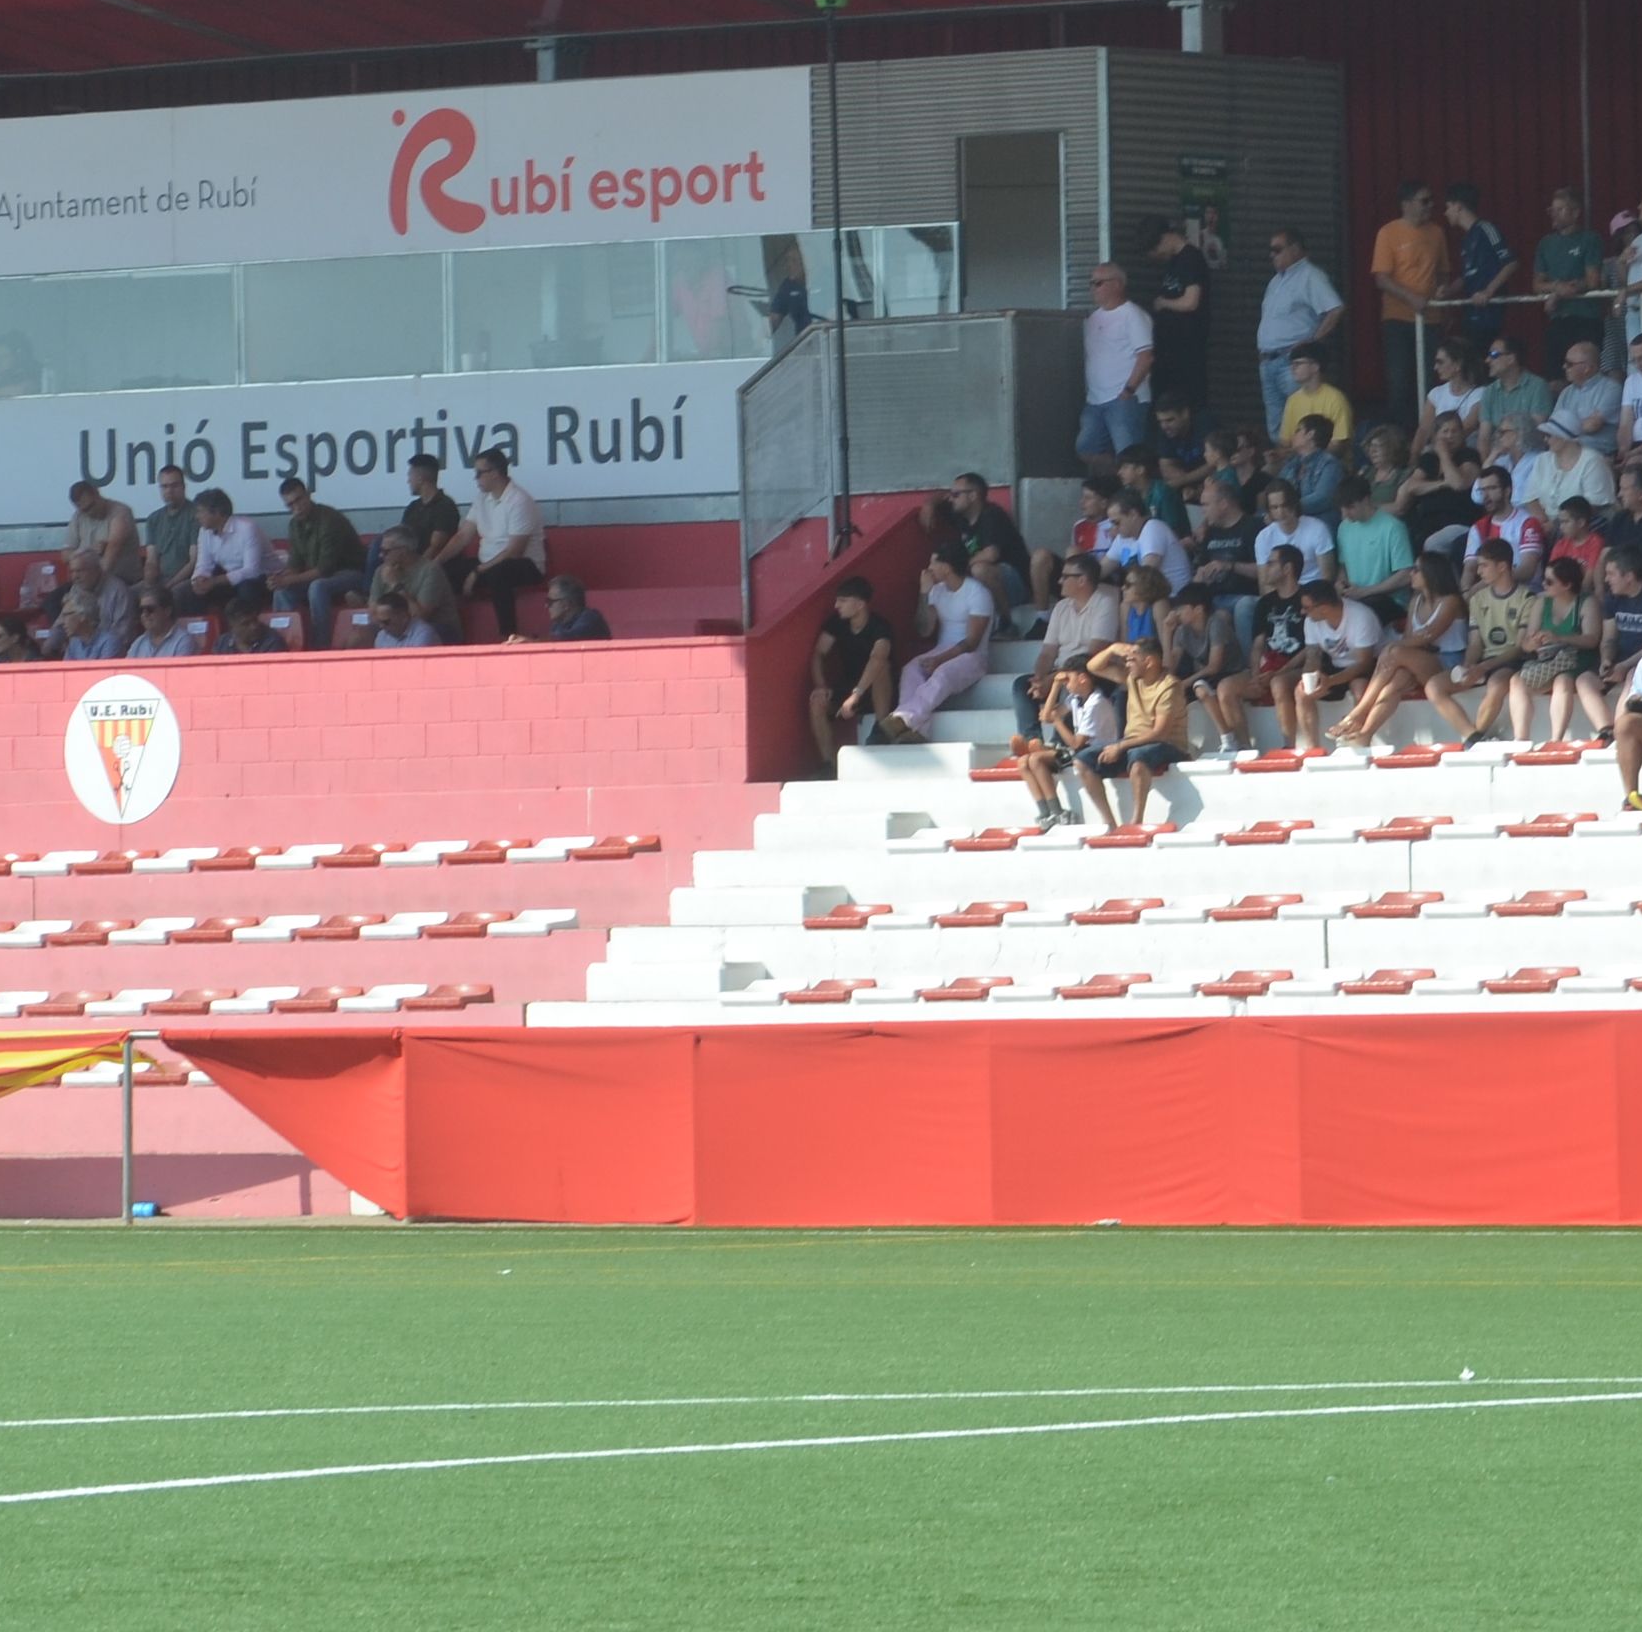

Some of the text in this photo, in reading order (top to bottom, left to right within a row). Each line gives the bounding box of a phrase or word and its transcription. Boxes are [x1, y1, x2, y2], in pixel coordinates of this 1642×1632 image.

[156, 180, 190, 213] de
[198, 175, 258, 210] Rubí
[388, 107, 766, 235] Rubí esport
[79, 394, 688, 494] Unió Esportiva Rubí
[89, 704, 117, 717] U.E.
